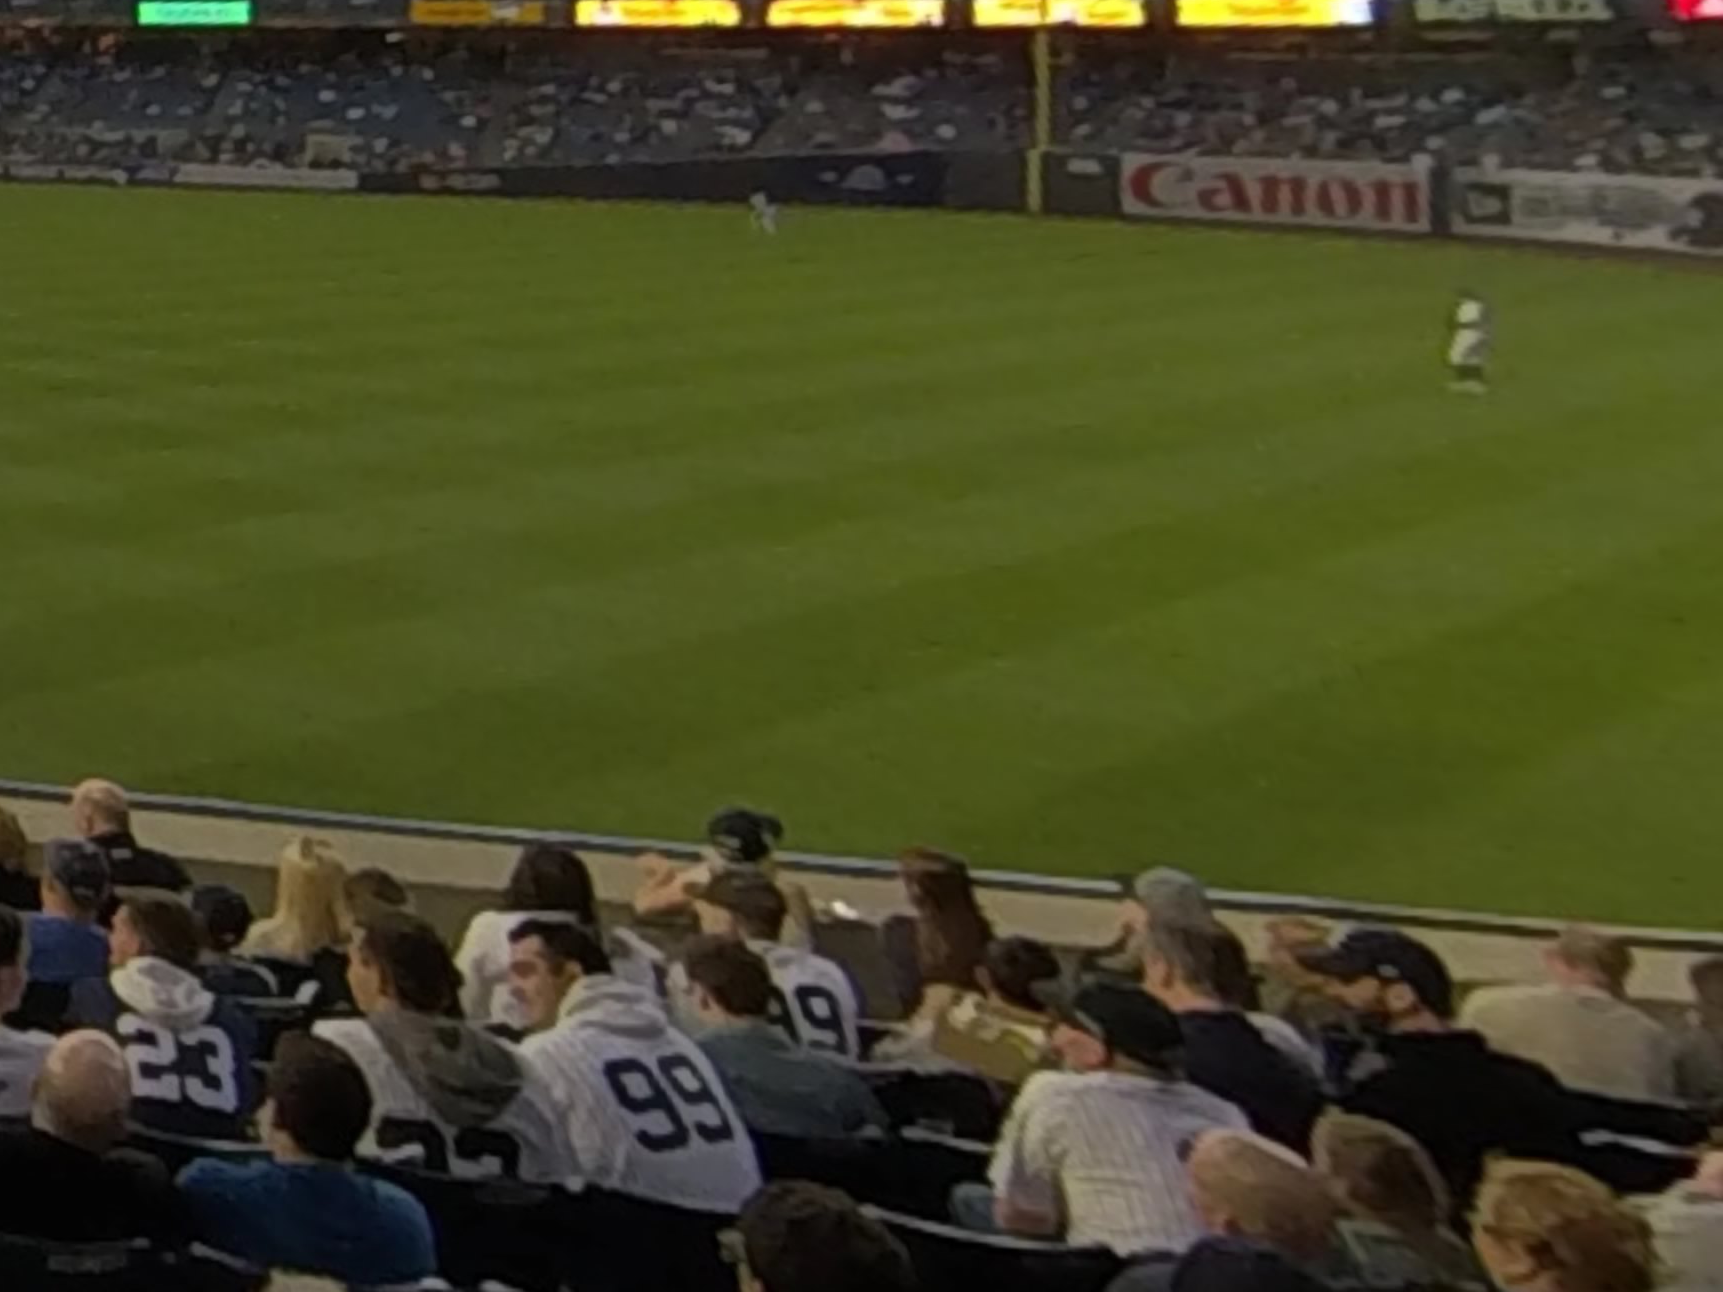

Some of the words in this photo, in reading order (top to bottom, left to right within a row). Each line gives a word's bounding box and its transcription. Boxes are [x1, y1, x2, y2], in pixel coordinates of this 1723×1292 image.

[1128, 160, 1423, 224] Canon
[115, 1014, 238, 1113] 23
[602, 1054, 736, 1153] 99
